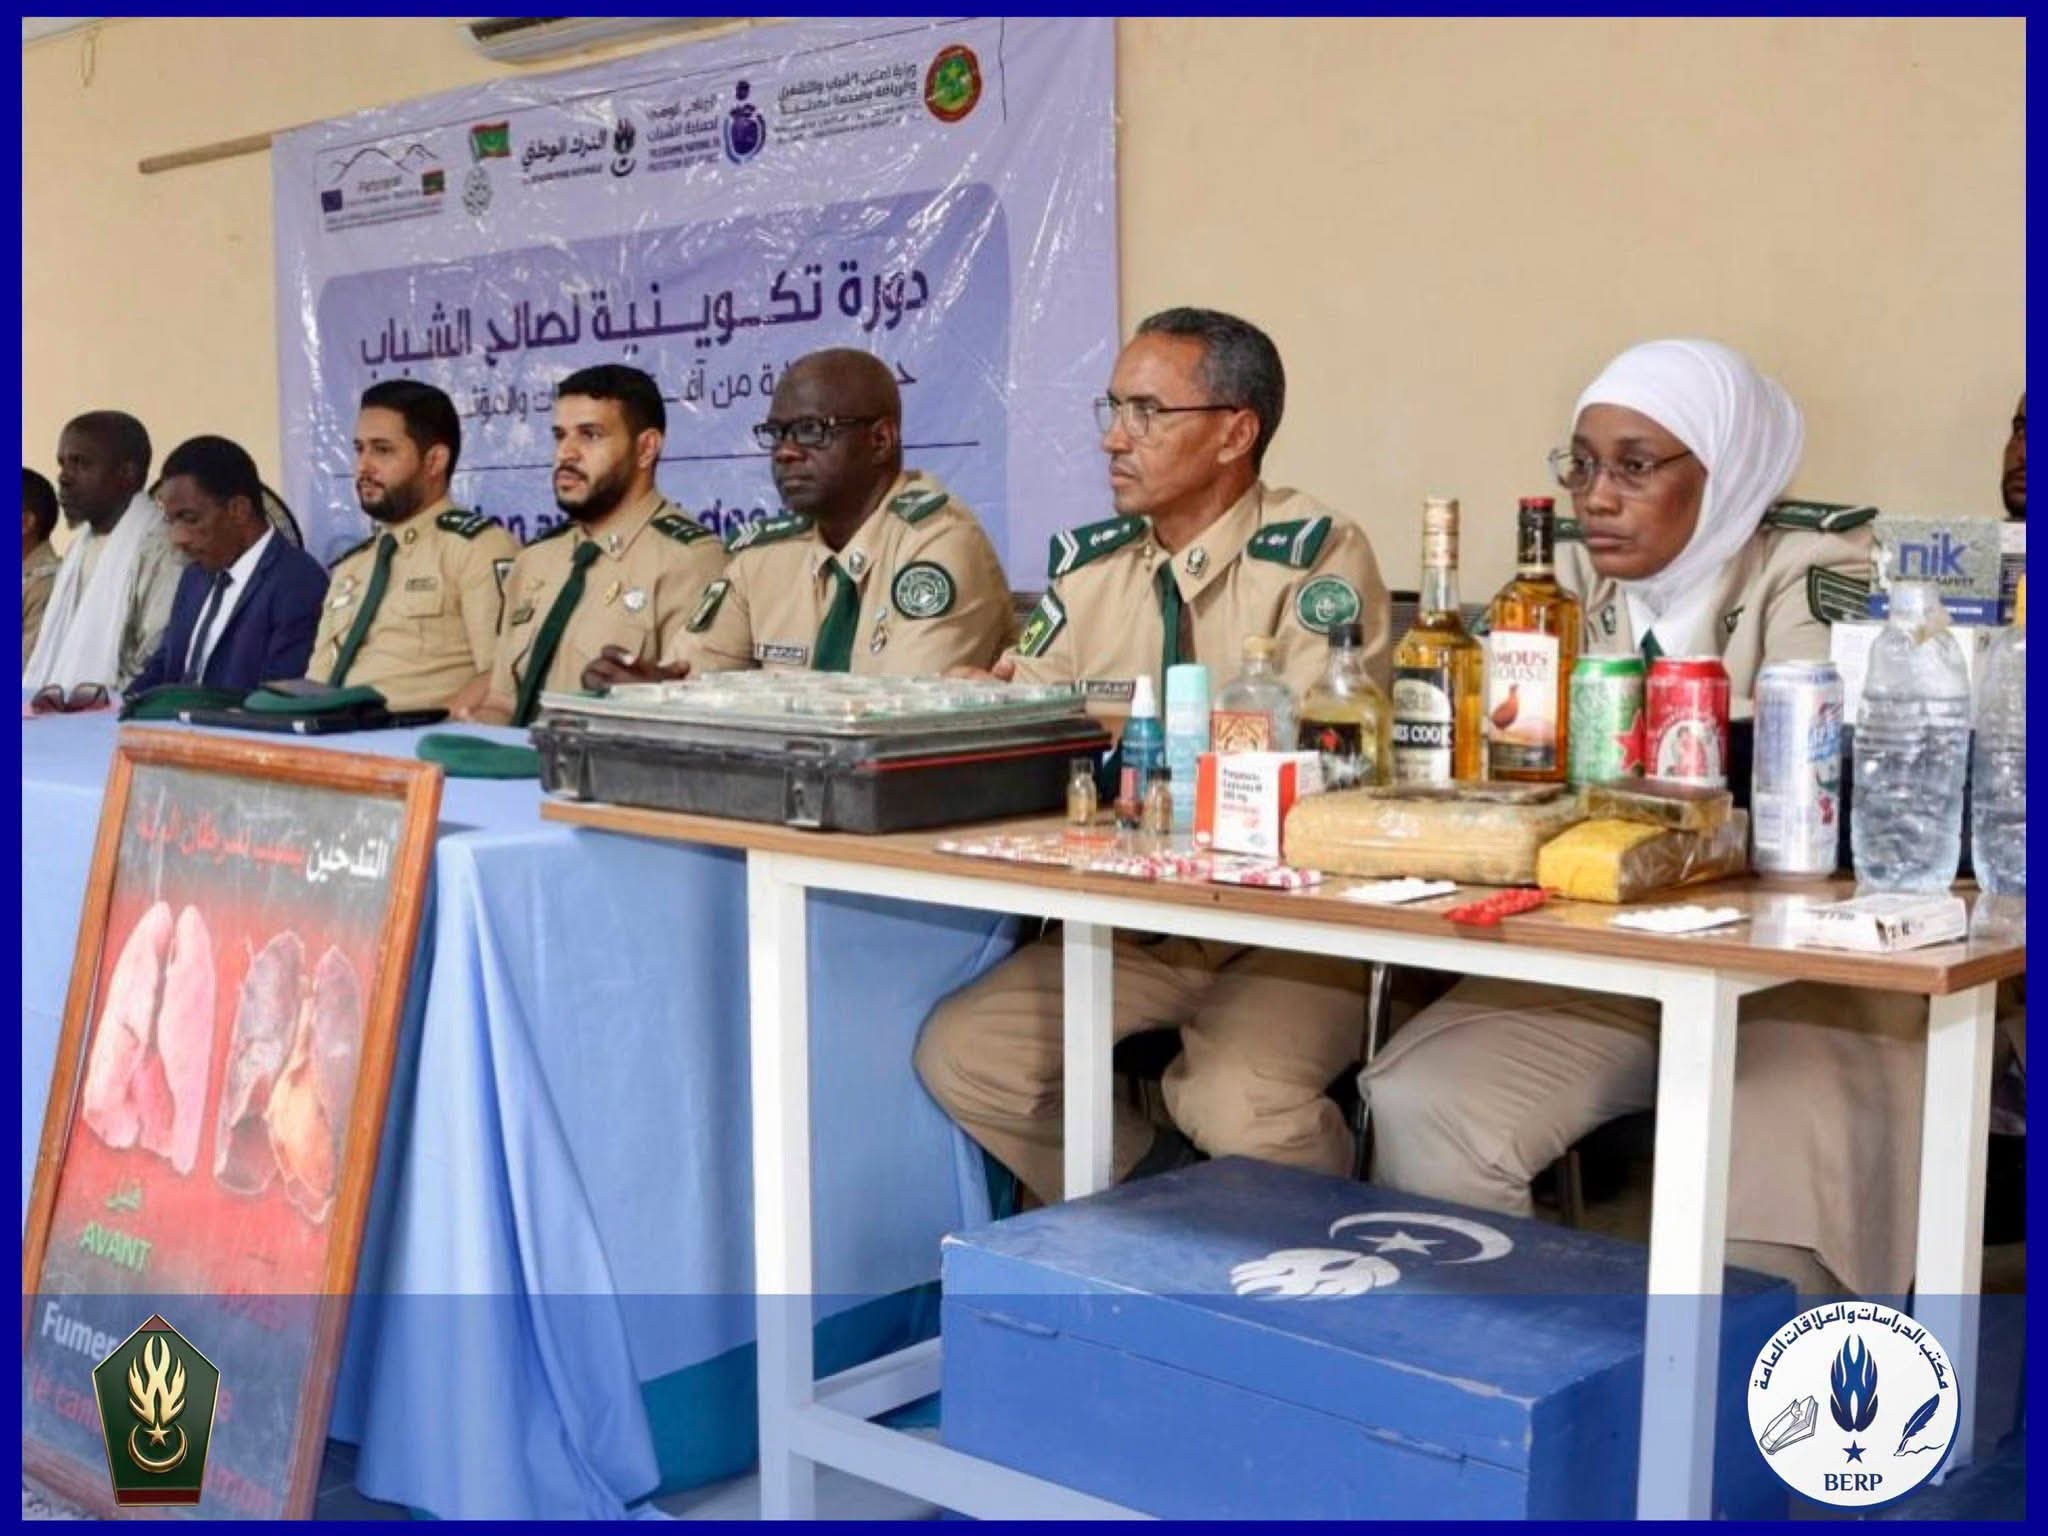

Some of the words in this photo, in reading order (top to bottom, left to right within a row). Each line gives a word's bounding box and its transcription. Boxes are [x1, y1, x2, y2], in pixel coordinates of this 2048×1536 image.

[591, 263, 823, 355] تكوينية
[838, 260, 930, 333] دورة
[360, 301, 472, 379] الشباب
[484, 293, 581, 367] لصالح
[711, 371, 752, 409] من
[1899, 532, 1968, 577] nik
[306, 831, 390, 883] التدخين
[79, 1219, 153, 1274] AVANT
[41, 1301, 120, 1361] Fumer
